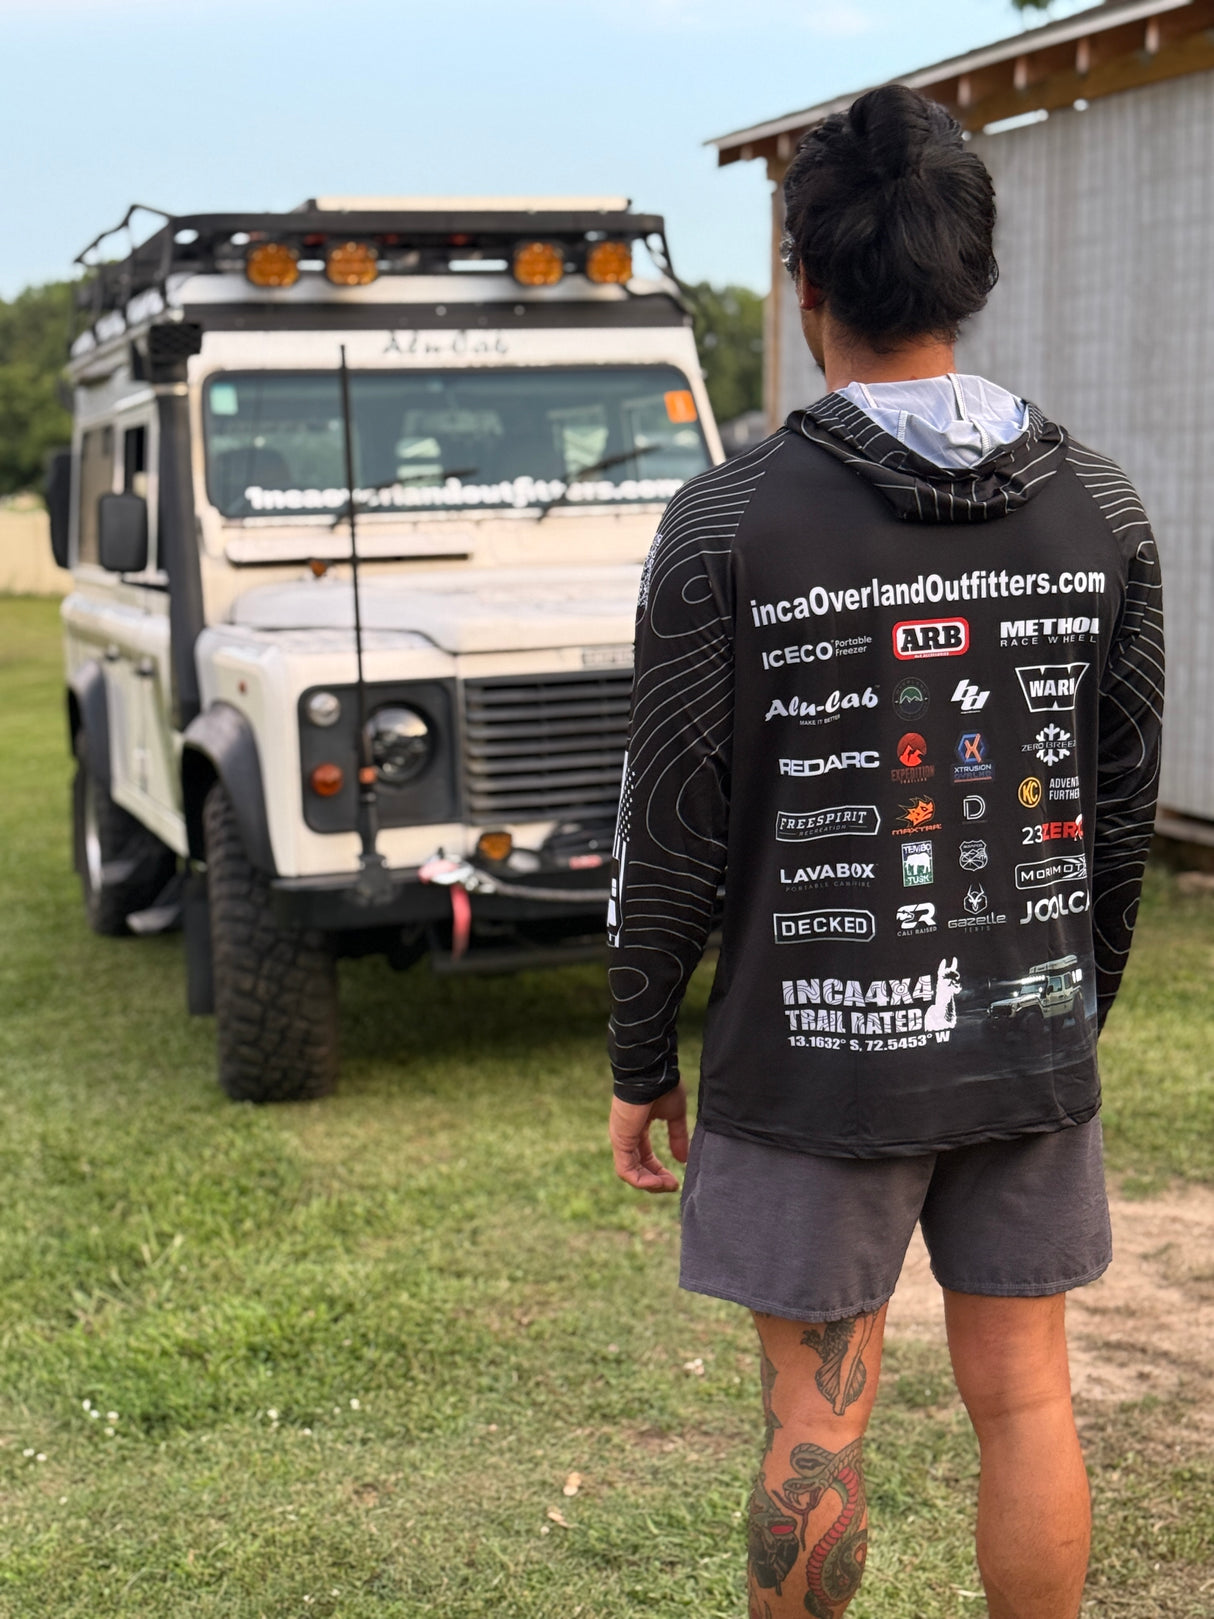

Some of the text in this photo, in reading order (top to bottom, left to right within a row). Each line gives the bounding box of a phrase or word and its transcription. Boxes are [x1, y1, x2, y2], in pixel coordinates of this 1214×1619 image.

[750, 569, 1105, 627] incaOverlandOutfitters.com
[834, 635, 873, 648] Portable
[900, 625, 963, 653] ARB
[1000, 637, 1039, 647] RACE
[761, 641, 833, 670] ICECO
[835, 645, 868, 657] Freezer
[765, 687, 879, 722] Alu-Cab
[824, 713, 841, 724] BETTER
[1021, 742, 1044, 752] ZERO
[778, 751, 880, 777] REDARC
[954, 763, 992, 773] XTRUSION
[1022, 780, 1038, 804] KC
[779, 811, 867, 830] FREESPIRIT
[903, 843, 931, 854] TEMBO
[780, 863, 875, 884] LAVABOX
[907, 874, 930, 885] TUSK
[784, 881, 830, 893] PORTABLE
[781, 917, 868, 937] DECKED
[897, 926, 937, 937] CALI RAISED
[782, 975, 934, 1007] INCA4X4
[785, 1008, 923, 1035] TRAIL RATED
[787, 1036, 846, 1050] 13.1632°
[865, 1033, 932, 1051] 72.5453°
[935, 1030, 951, 1043] W
